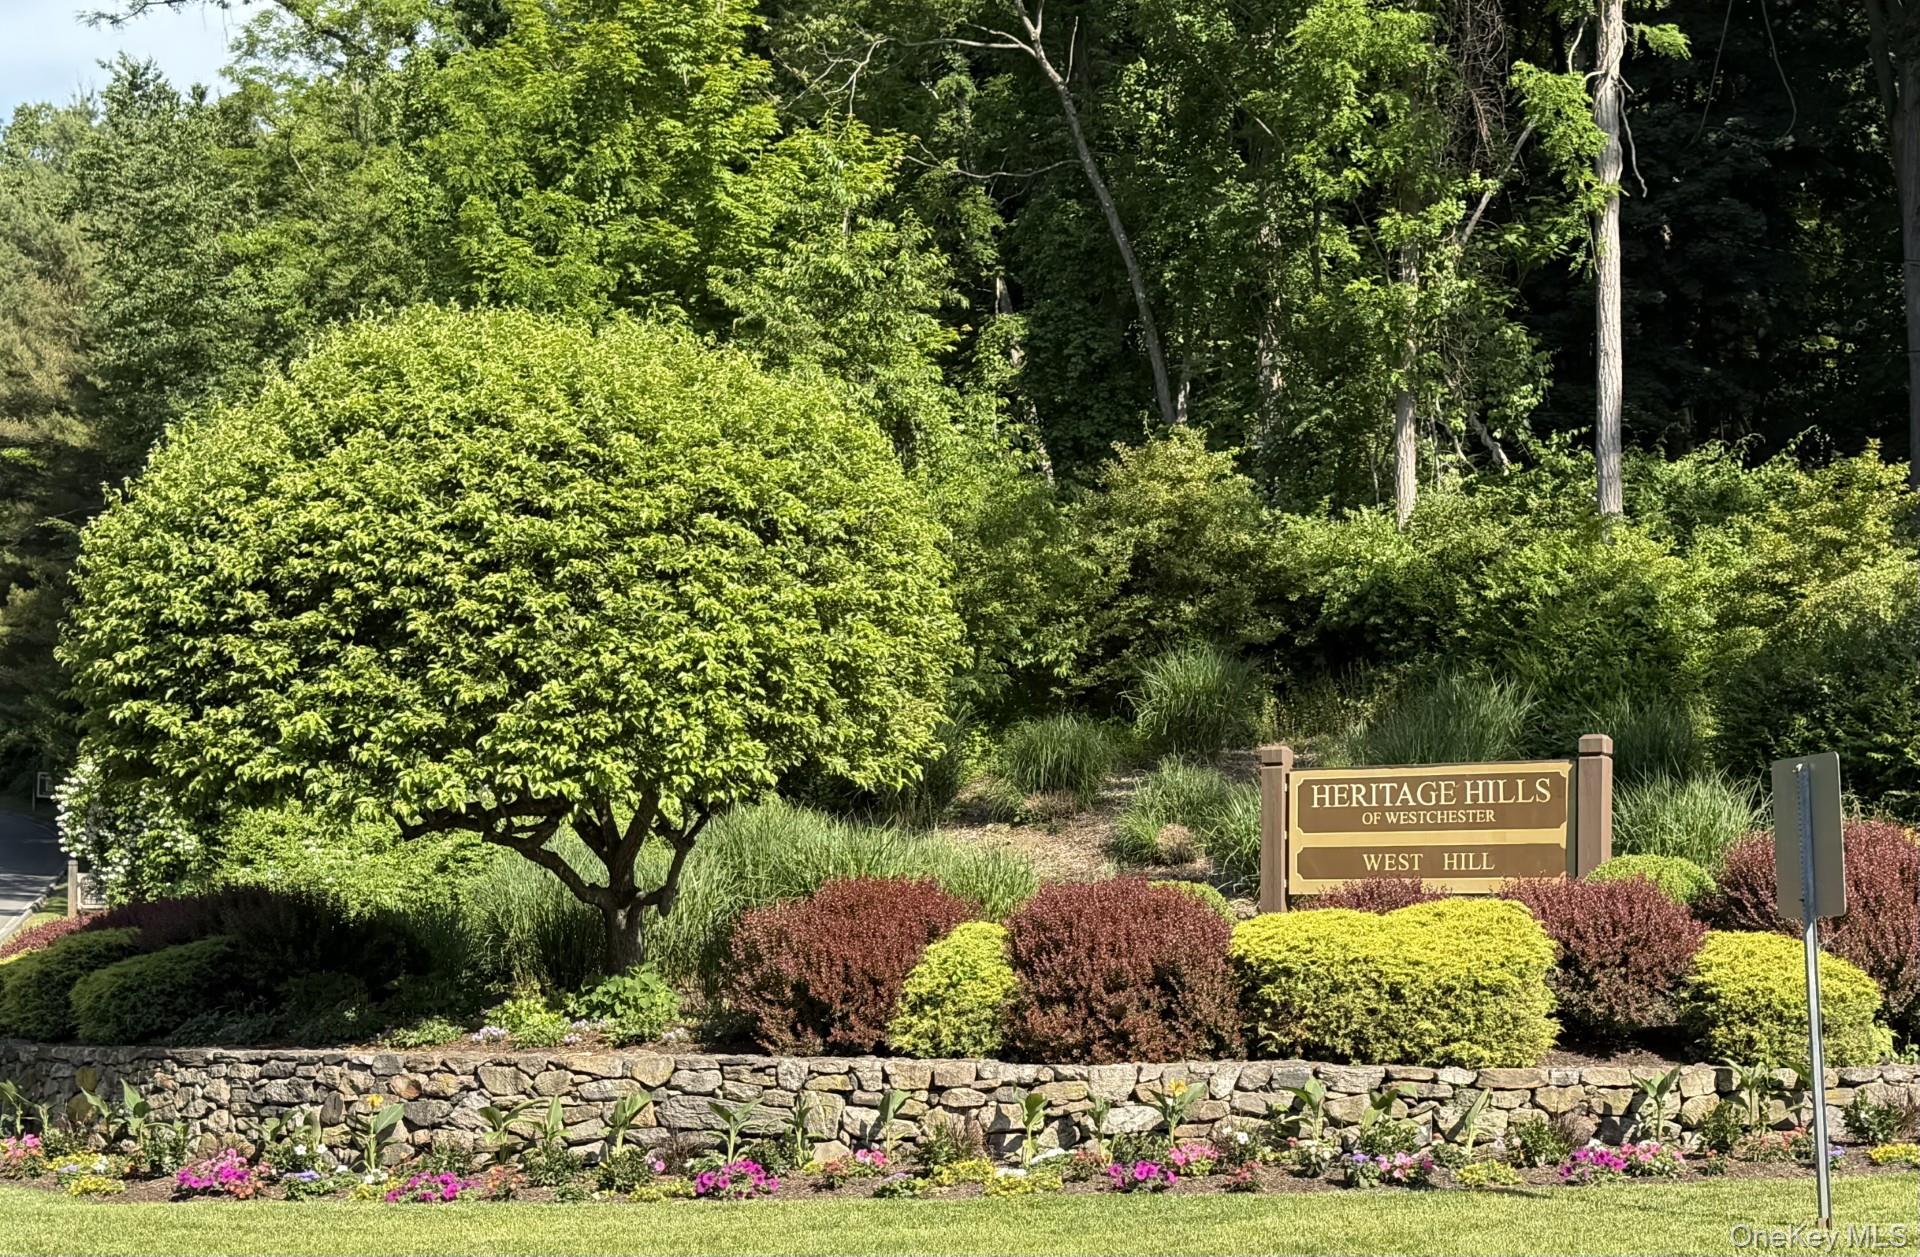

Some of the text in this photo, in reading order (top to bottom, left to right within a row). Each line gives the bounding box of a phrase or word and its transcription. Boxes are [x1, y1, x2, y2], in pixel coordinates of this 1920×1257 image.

[1311, 778, 1551, 808] HERITAGE HILLS
[1362, 810, 1497, 825] OF WESTCHESTER
[1363, 852, 1496, 871] WEST HILL
